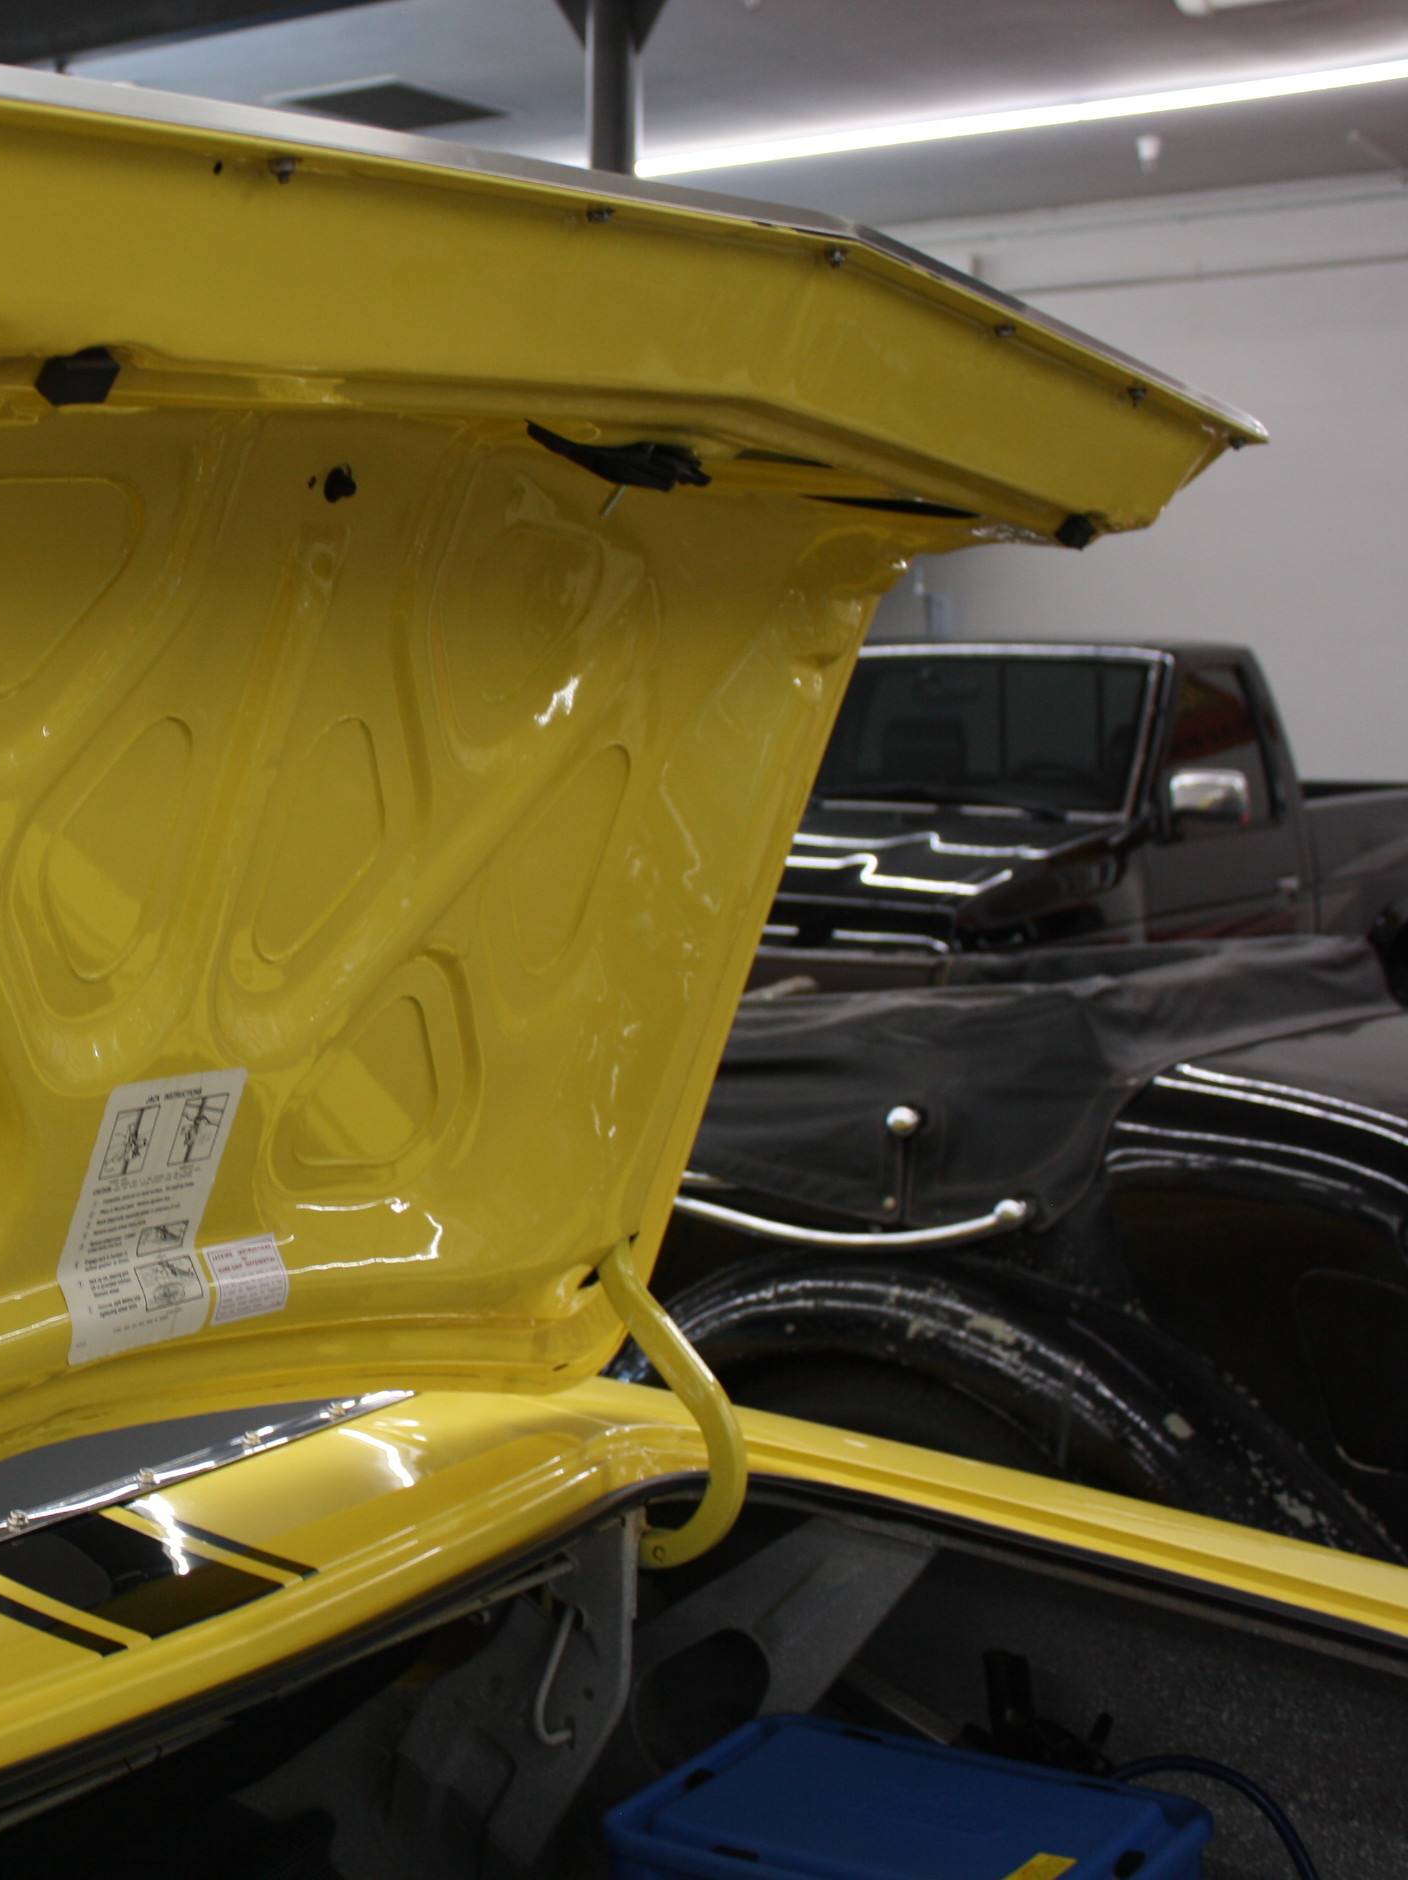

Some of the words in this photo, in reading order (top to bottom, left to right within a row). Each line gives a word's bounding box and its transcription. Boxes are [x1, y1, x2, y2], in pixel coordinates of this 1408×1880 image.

[164, 1086, 203, 1100] INSTRUCTIONS
[212, 1251, 233, 1261] JACKING
[237, 1244, 271, 1255] INSTRUCTIONS
